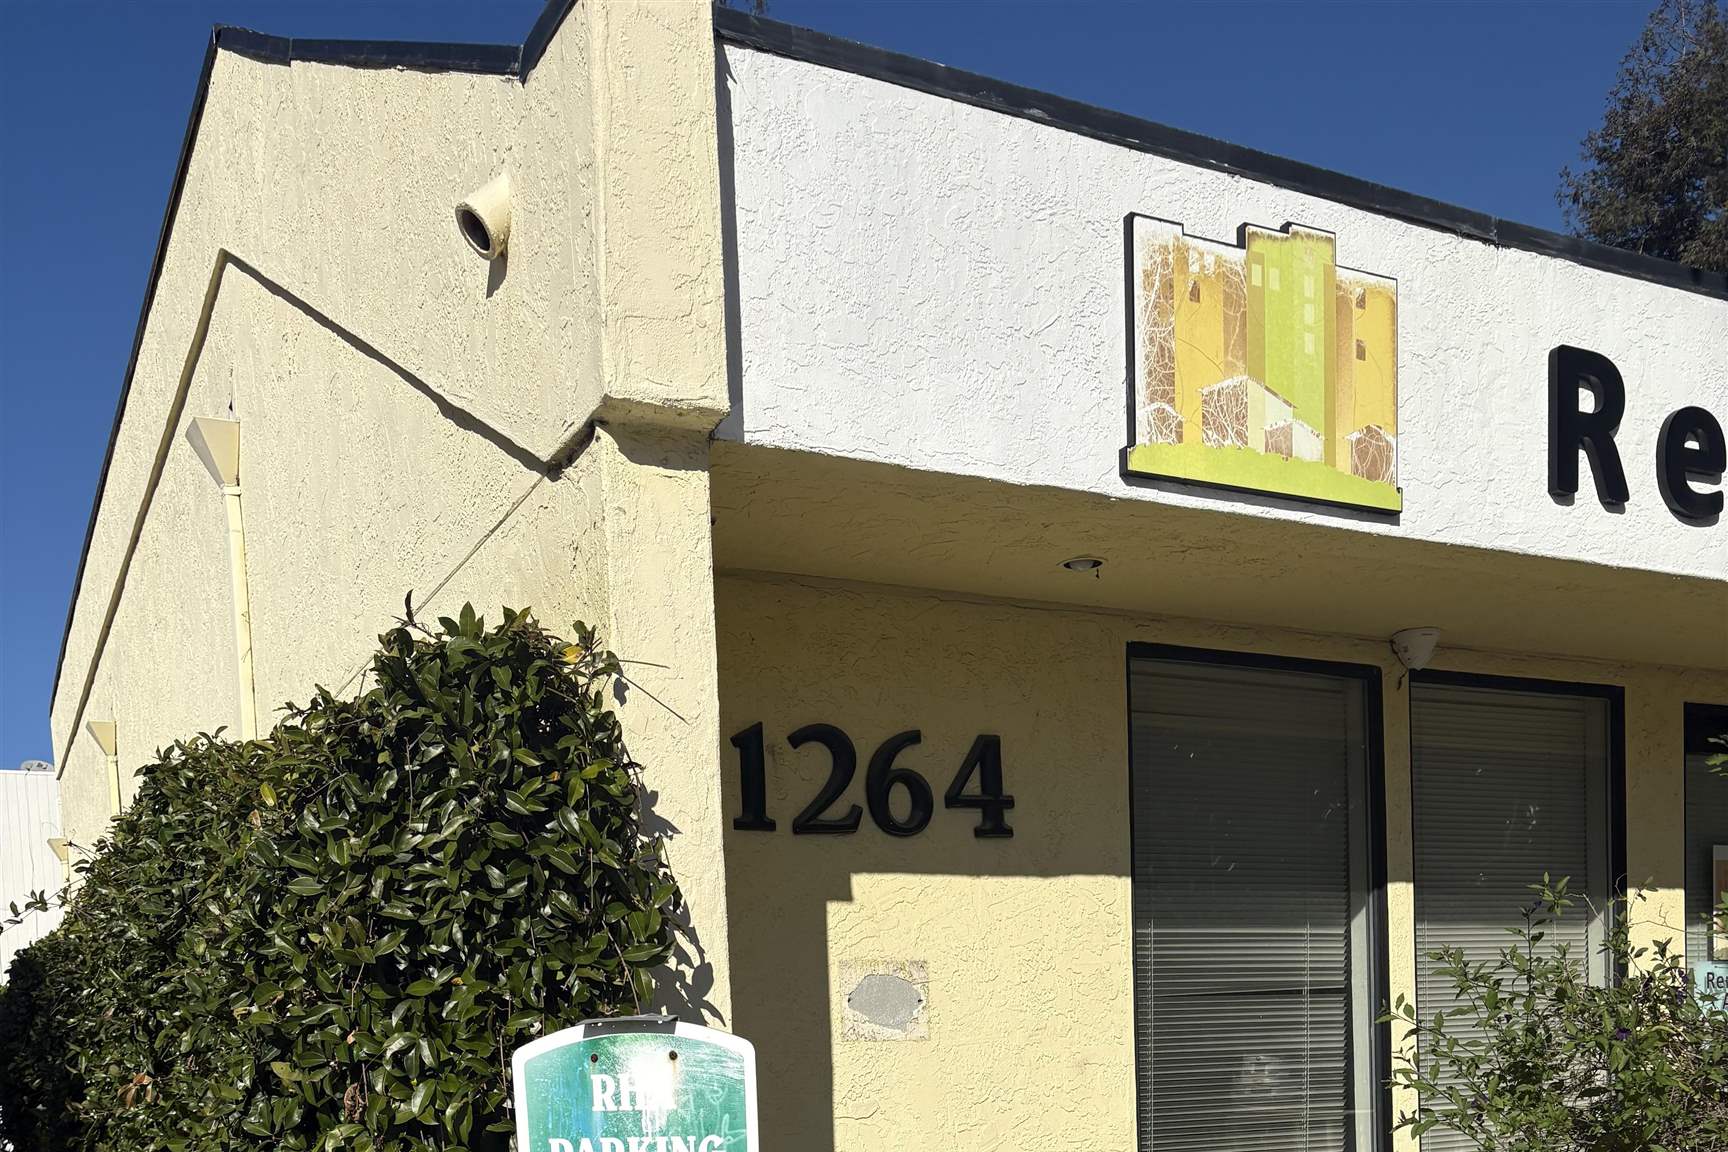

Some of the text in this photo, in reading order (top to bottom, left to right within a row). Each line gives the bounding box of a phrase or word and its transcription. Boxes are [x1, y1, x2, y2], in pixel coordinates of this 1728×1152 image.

[1548, 344, 1727, 523] Re
[730, 721, 1015, 838] 1264
[1707, 972, 1728, 989] Re
[591, 1074, 677, 1112] RH
